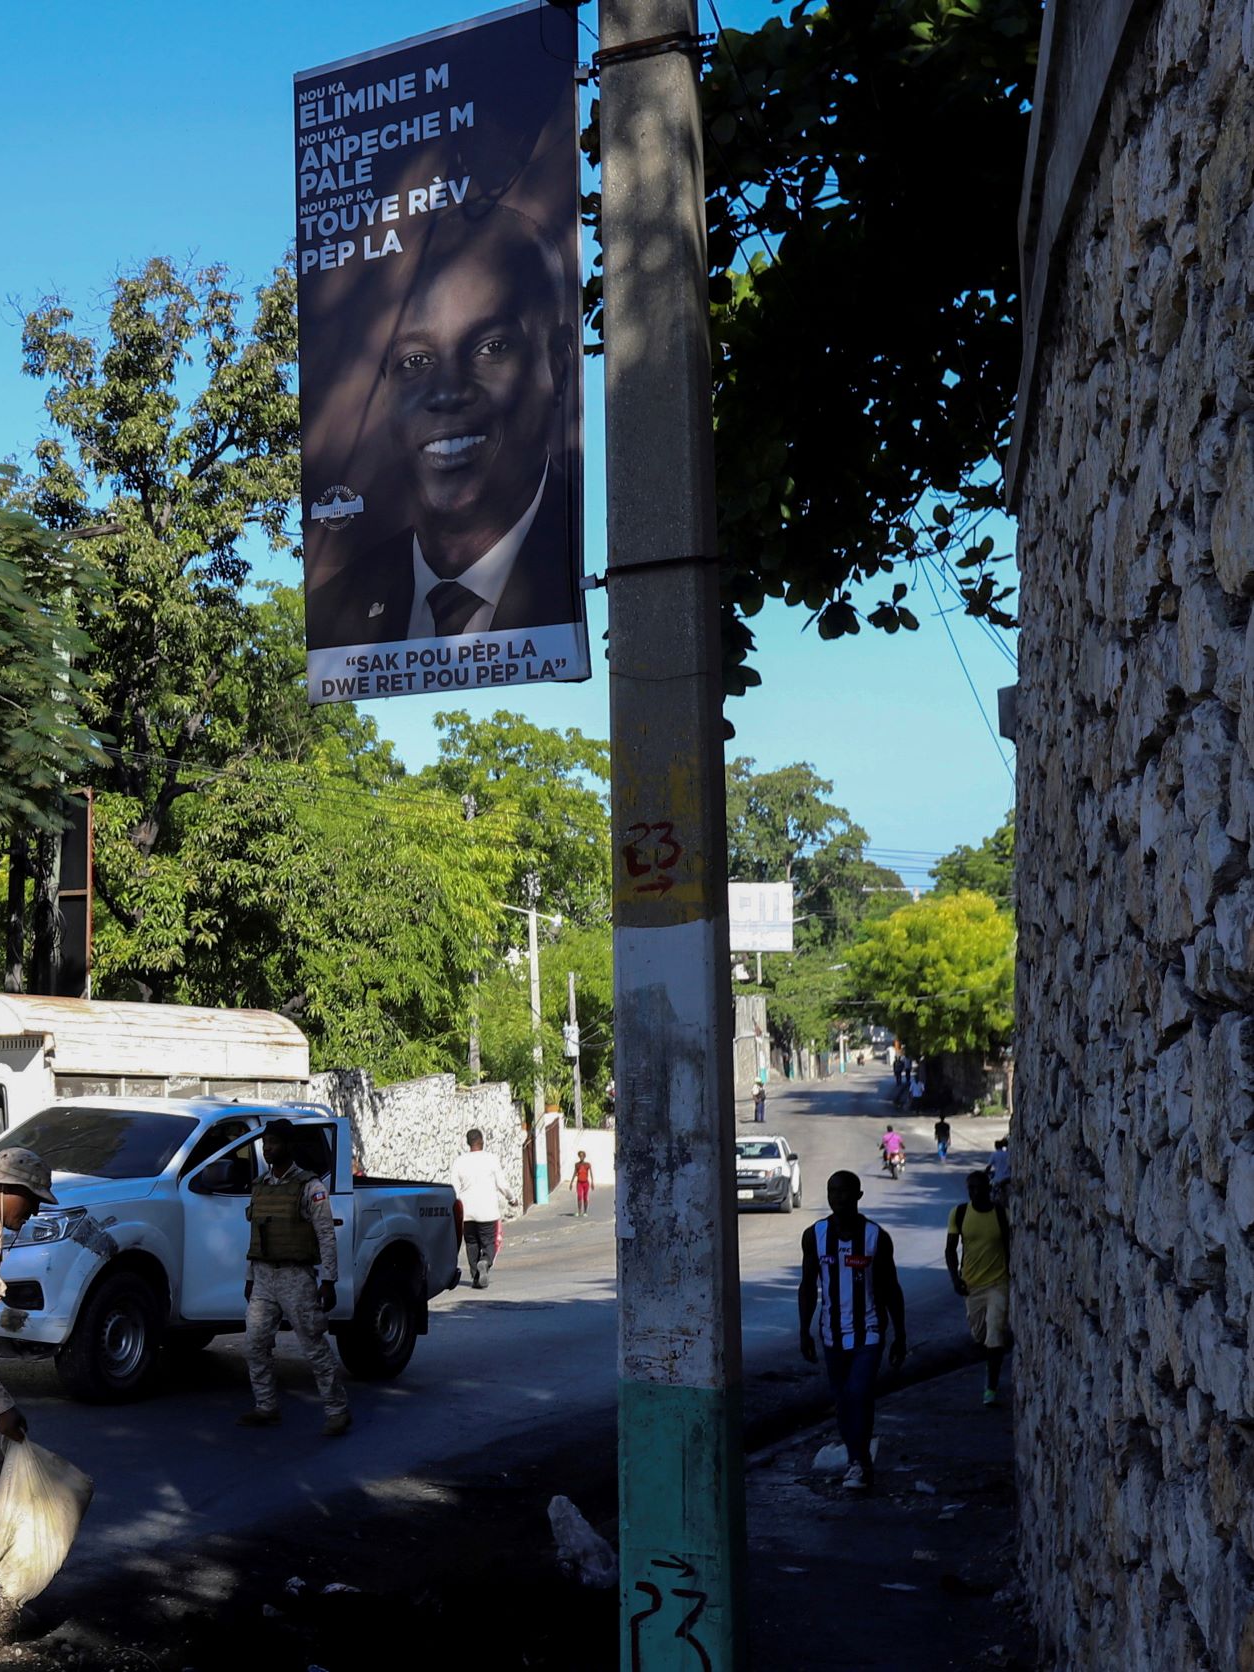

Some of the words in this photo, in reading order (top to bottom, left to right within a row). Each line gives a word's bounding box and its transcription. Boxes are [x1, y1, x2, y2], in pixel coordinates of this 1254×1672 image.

[299, 87, 325, 104] NOU
[328, 81, 346, 96] KA
[300, 73, 416, 129] ELIMINE
[426, 63, 449, 93] M
[299, 131, 325, 147] NOU
[328, 125, 346, 140] KA
[300, 111, 440, 173] ANPECHE
[450, 102, 474, 132] M
[300, 157, 372, 198] PALE
[300, 200, 326, 216] NOU
[330, 195, 354, 210] PAP
[357, 189, 374, 202] KA
[300, 194, 399, 241] TOUYE
[408, 175, 470, 216] RÈV
[301, 238, 355, 275] PÈP
[363, 228, 403, 261] LA
[406, 648, 451, 668] POU
[458, 639, 501, 663] PÈP
[507, 639, 537, 659] LA
[321, 677, 369, 697] DWE
[376, 672, 416, 693] RET
[423, 667, 469, 689] POU
[476, 660, 519, 684] PÈP
